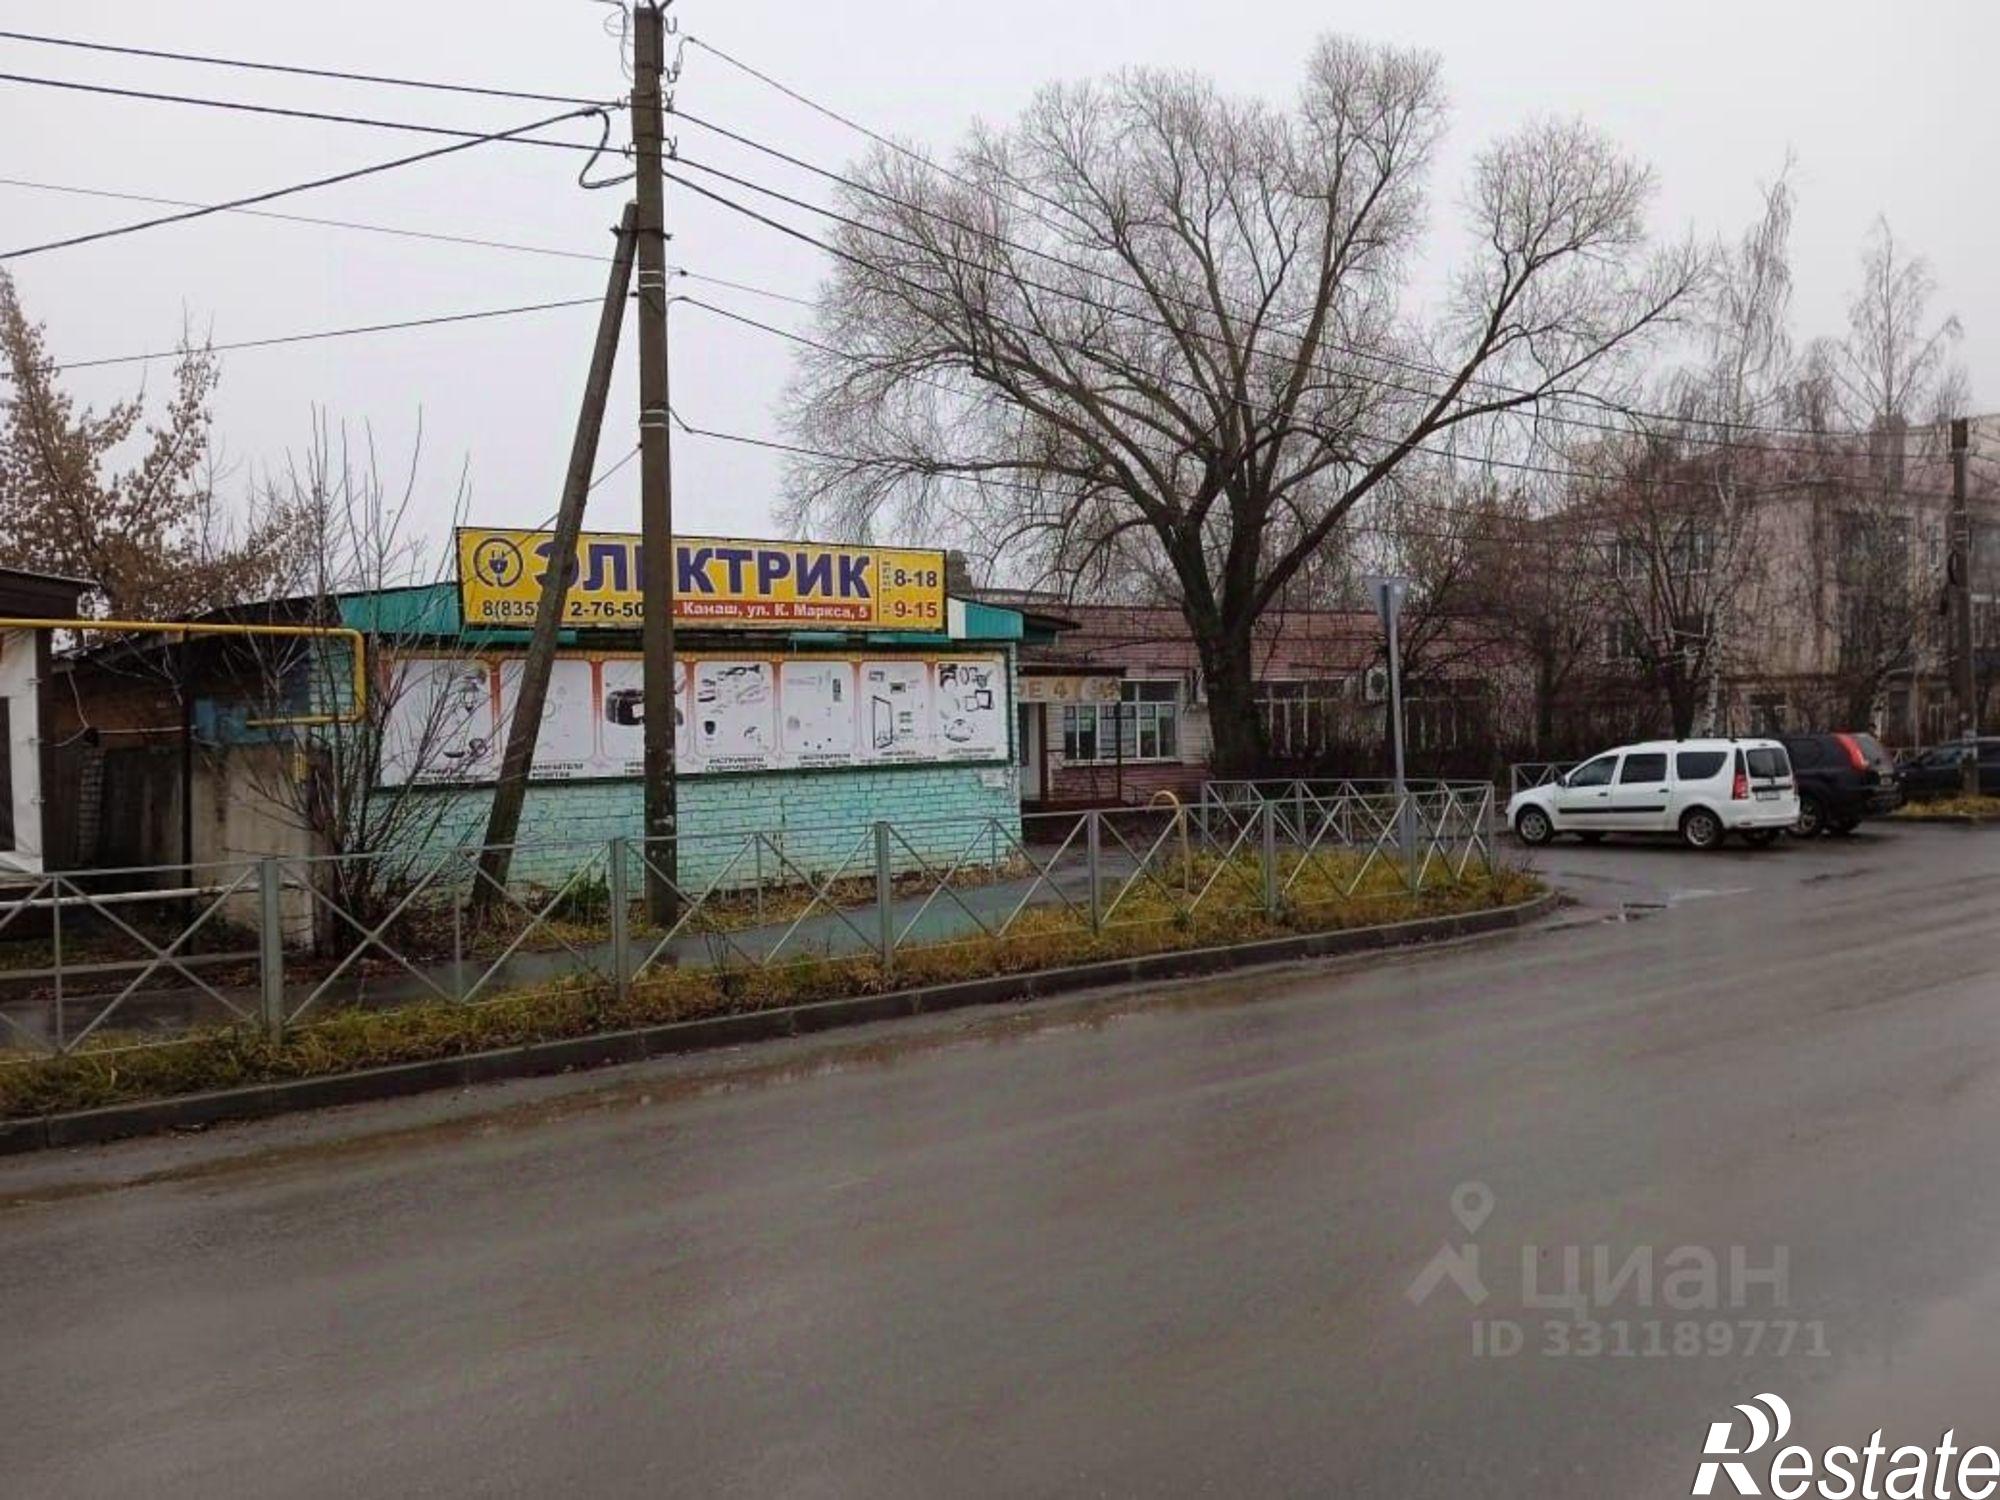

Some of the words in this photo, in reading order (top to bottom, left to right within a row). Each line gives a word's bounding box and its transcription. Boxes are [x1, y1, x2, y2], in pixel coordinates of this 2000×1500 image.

[534, 541, 871, 598] ЭЛКТРИК
[894, 569, 938, 587] 8-18
[570, 600, 645, 617] 2-76-50
[683, 601, 743, 617] Канаш,
[747, 605, 770, 618] ул.
[774, 603, 789, 616] К.
[793, 603, 855, 620] Маркса,
[894, 600, 938, 618] 9-15
